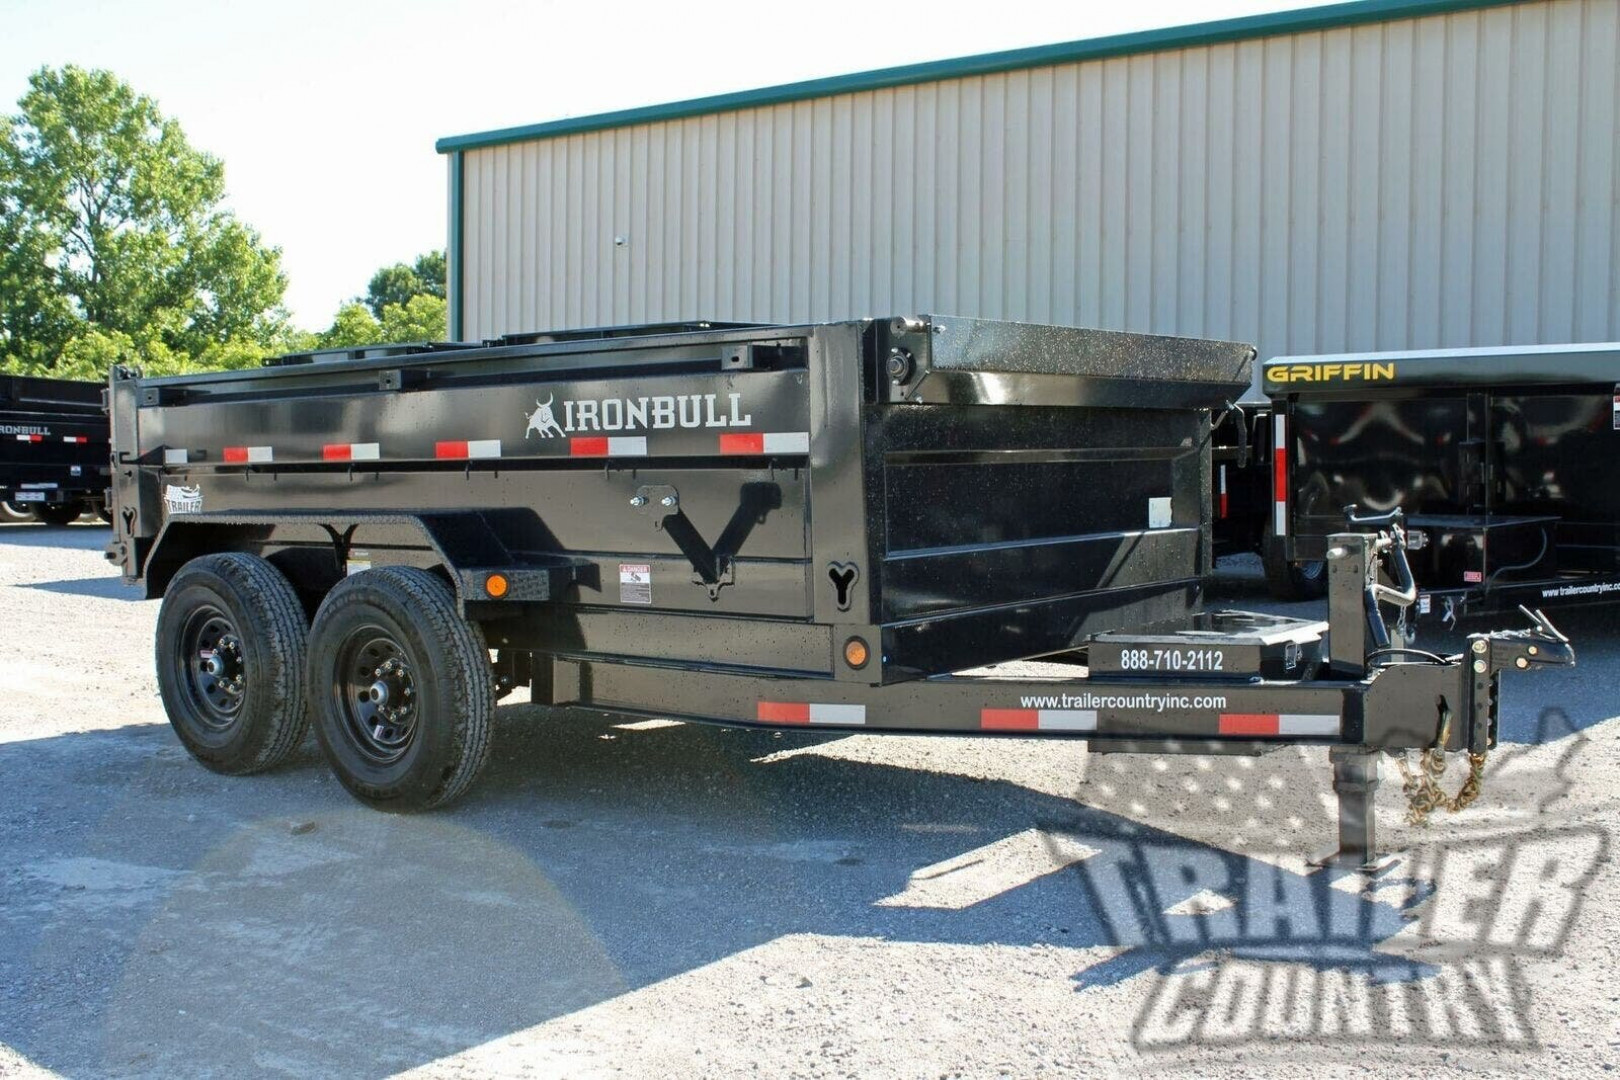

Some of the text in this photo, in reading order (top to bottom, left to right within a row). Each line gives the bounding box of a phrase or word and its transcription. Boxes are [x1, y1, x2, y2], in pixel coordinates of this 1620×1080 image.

[1267, 363, 1395, 382] GRIFFIN
[563, 393, 752, 432] IRONBULL
[1121, 650, 1224, 670] 888-710-2112
[1020, 693, 1227, 713] www.trailercountryinc.com
